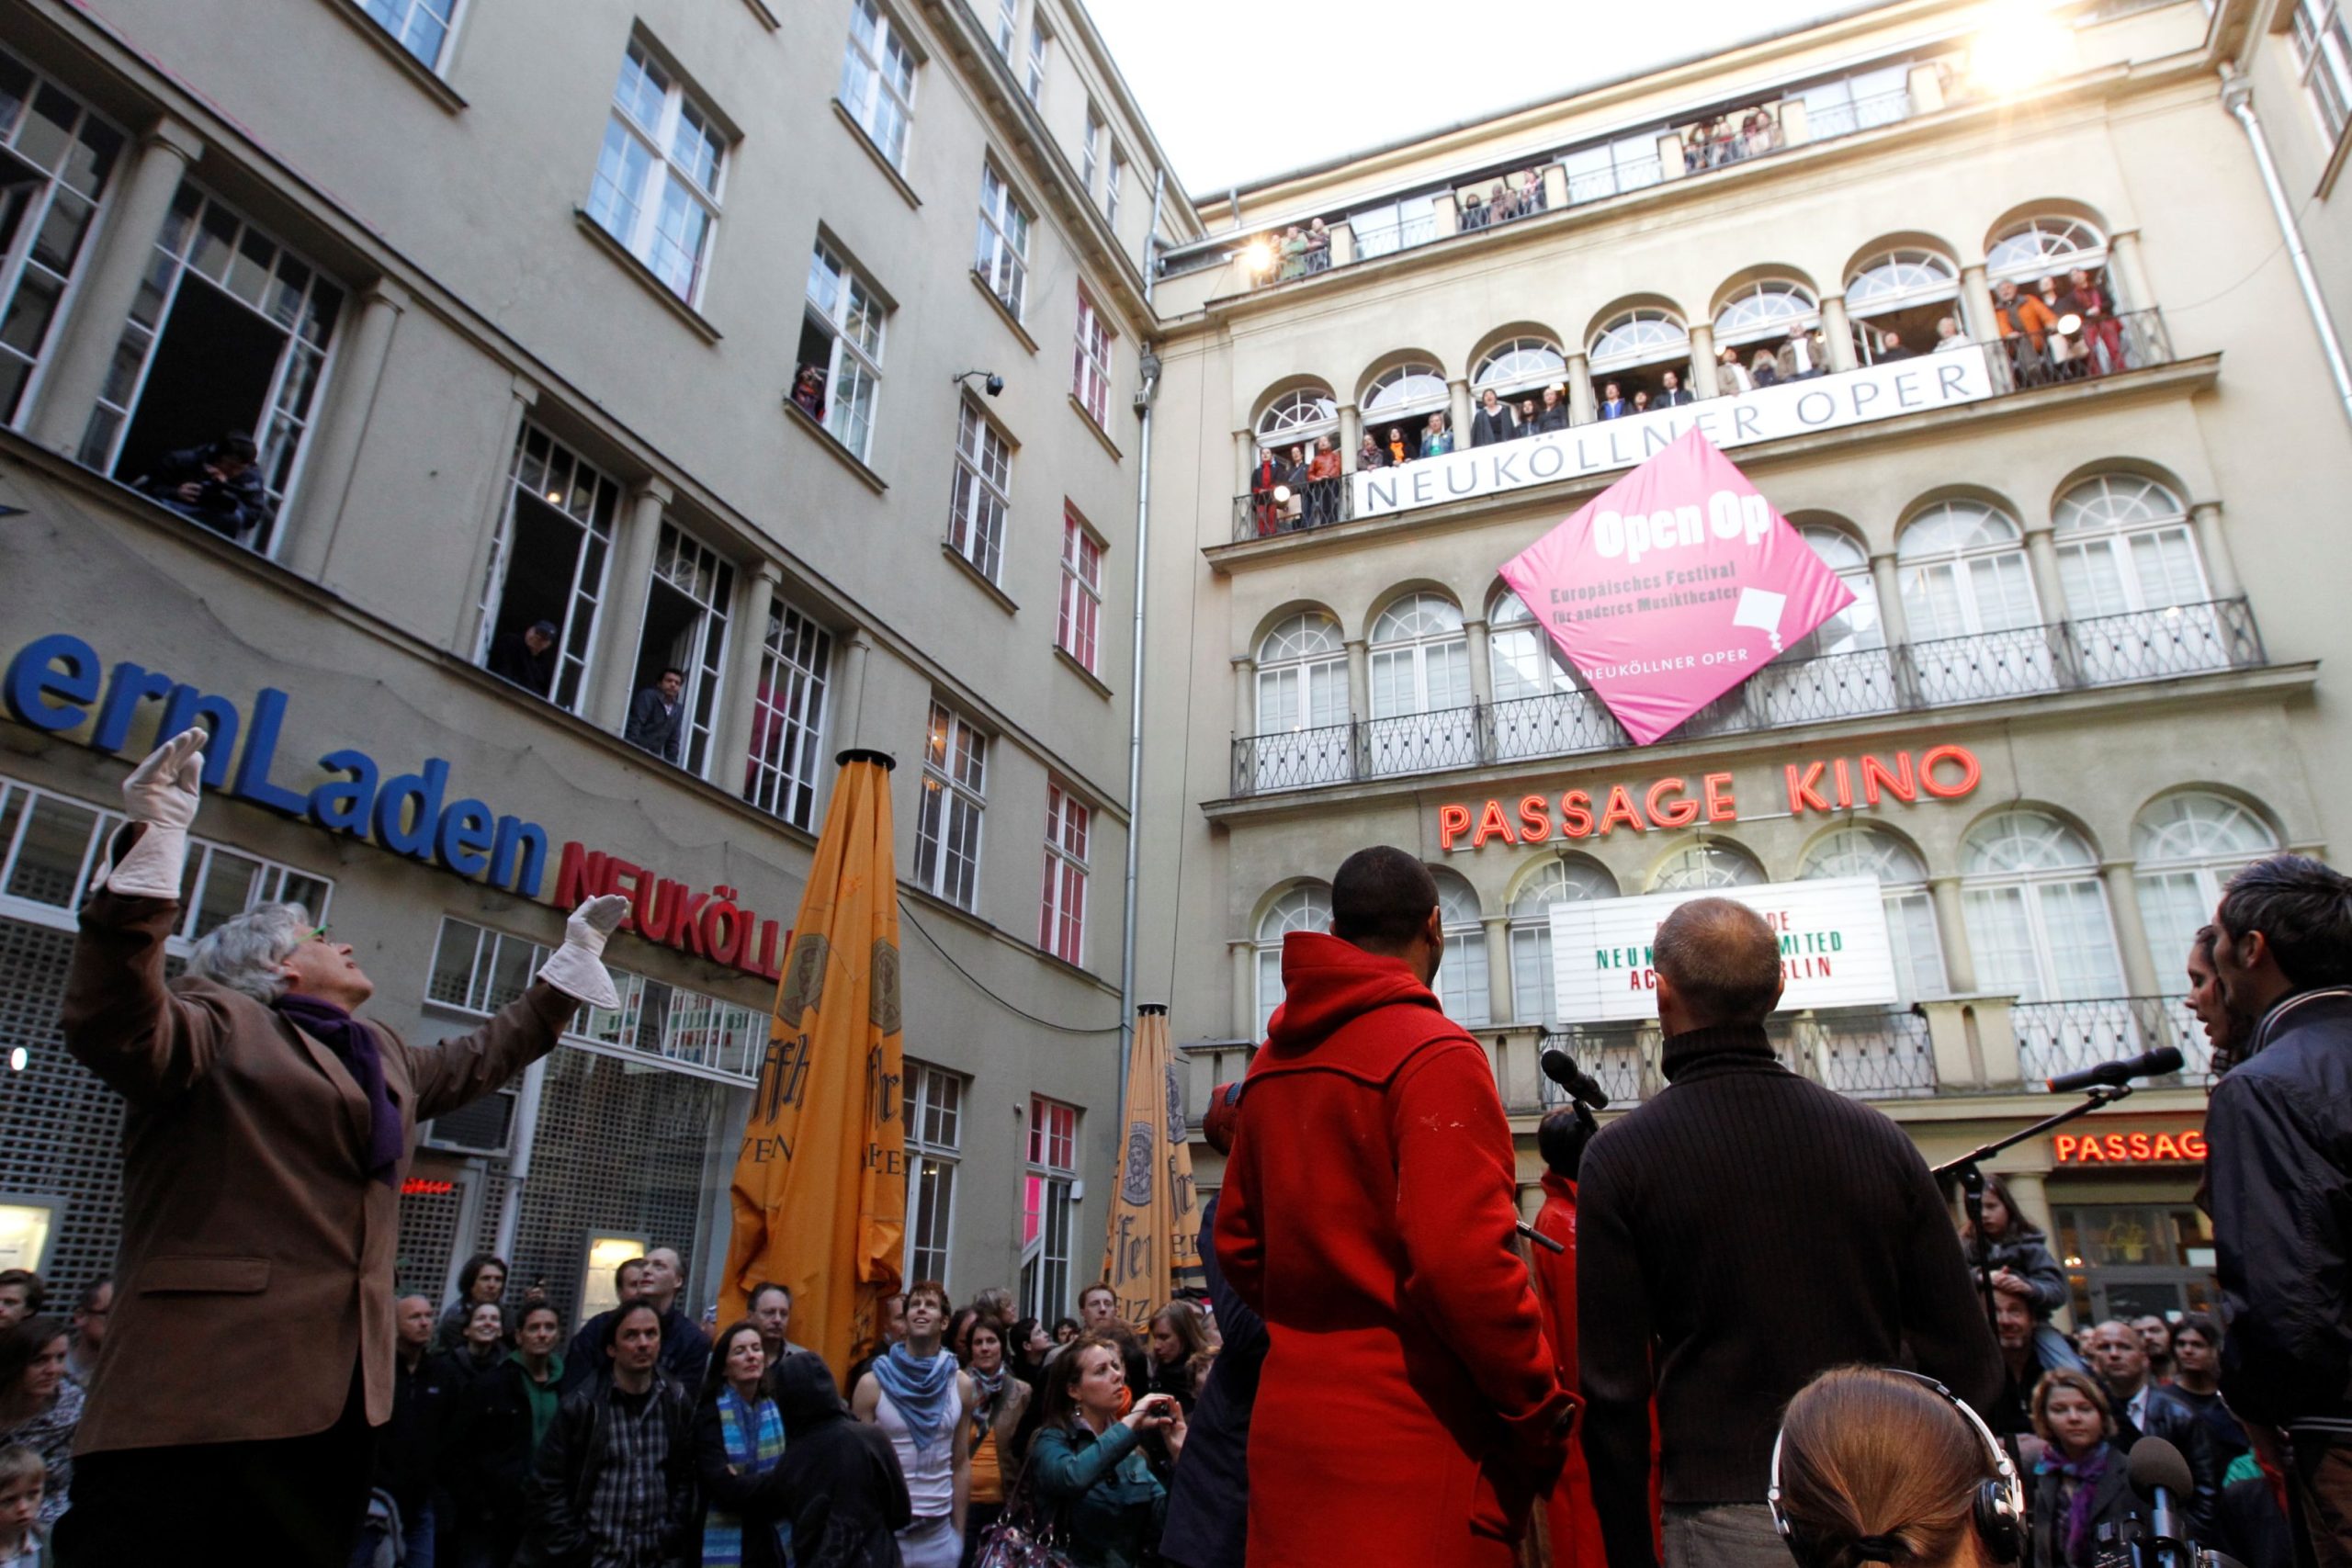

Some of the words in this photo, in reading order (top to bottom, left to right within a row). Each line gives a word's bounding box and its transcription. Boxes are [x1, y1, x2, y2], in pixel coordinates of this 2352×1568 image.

[1367, 406, 1761, 511] NEUKÖLLNER
[1797, 364, 1970, 424] OPER
[1592, 503, 1704, 564] Open
[1708, 490, 1770, 545] Op
[1550, 574, 1661, 604] Europäisches
[1666, 561, 1736, 586] Festival
[1553, 610, 1571, 625] für
[1577, 604, 1634, 622] anderes
[1637, 587, 1738, 613] Musiktheater
[1581, 656, 1696, 681] NEUKÖLLNER
[1702, 649, 1748, 666] OPER
[1440, 773, 1737, 851] PASSAGE
[1784, 745, 1982, 814] KINO
[553, 840, 793, 981] NEUKÖLL
[1597, 946, 1655, 969] NEUK
[1777, 931, 1842, 955] MITED
[1780, 956, 1831, 980] RLIN
[2054, 1129, 2207, 1162] PASSAG
